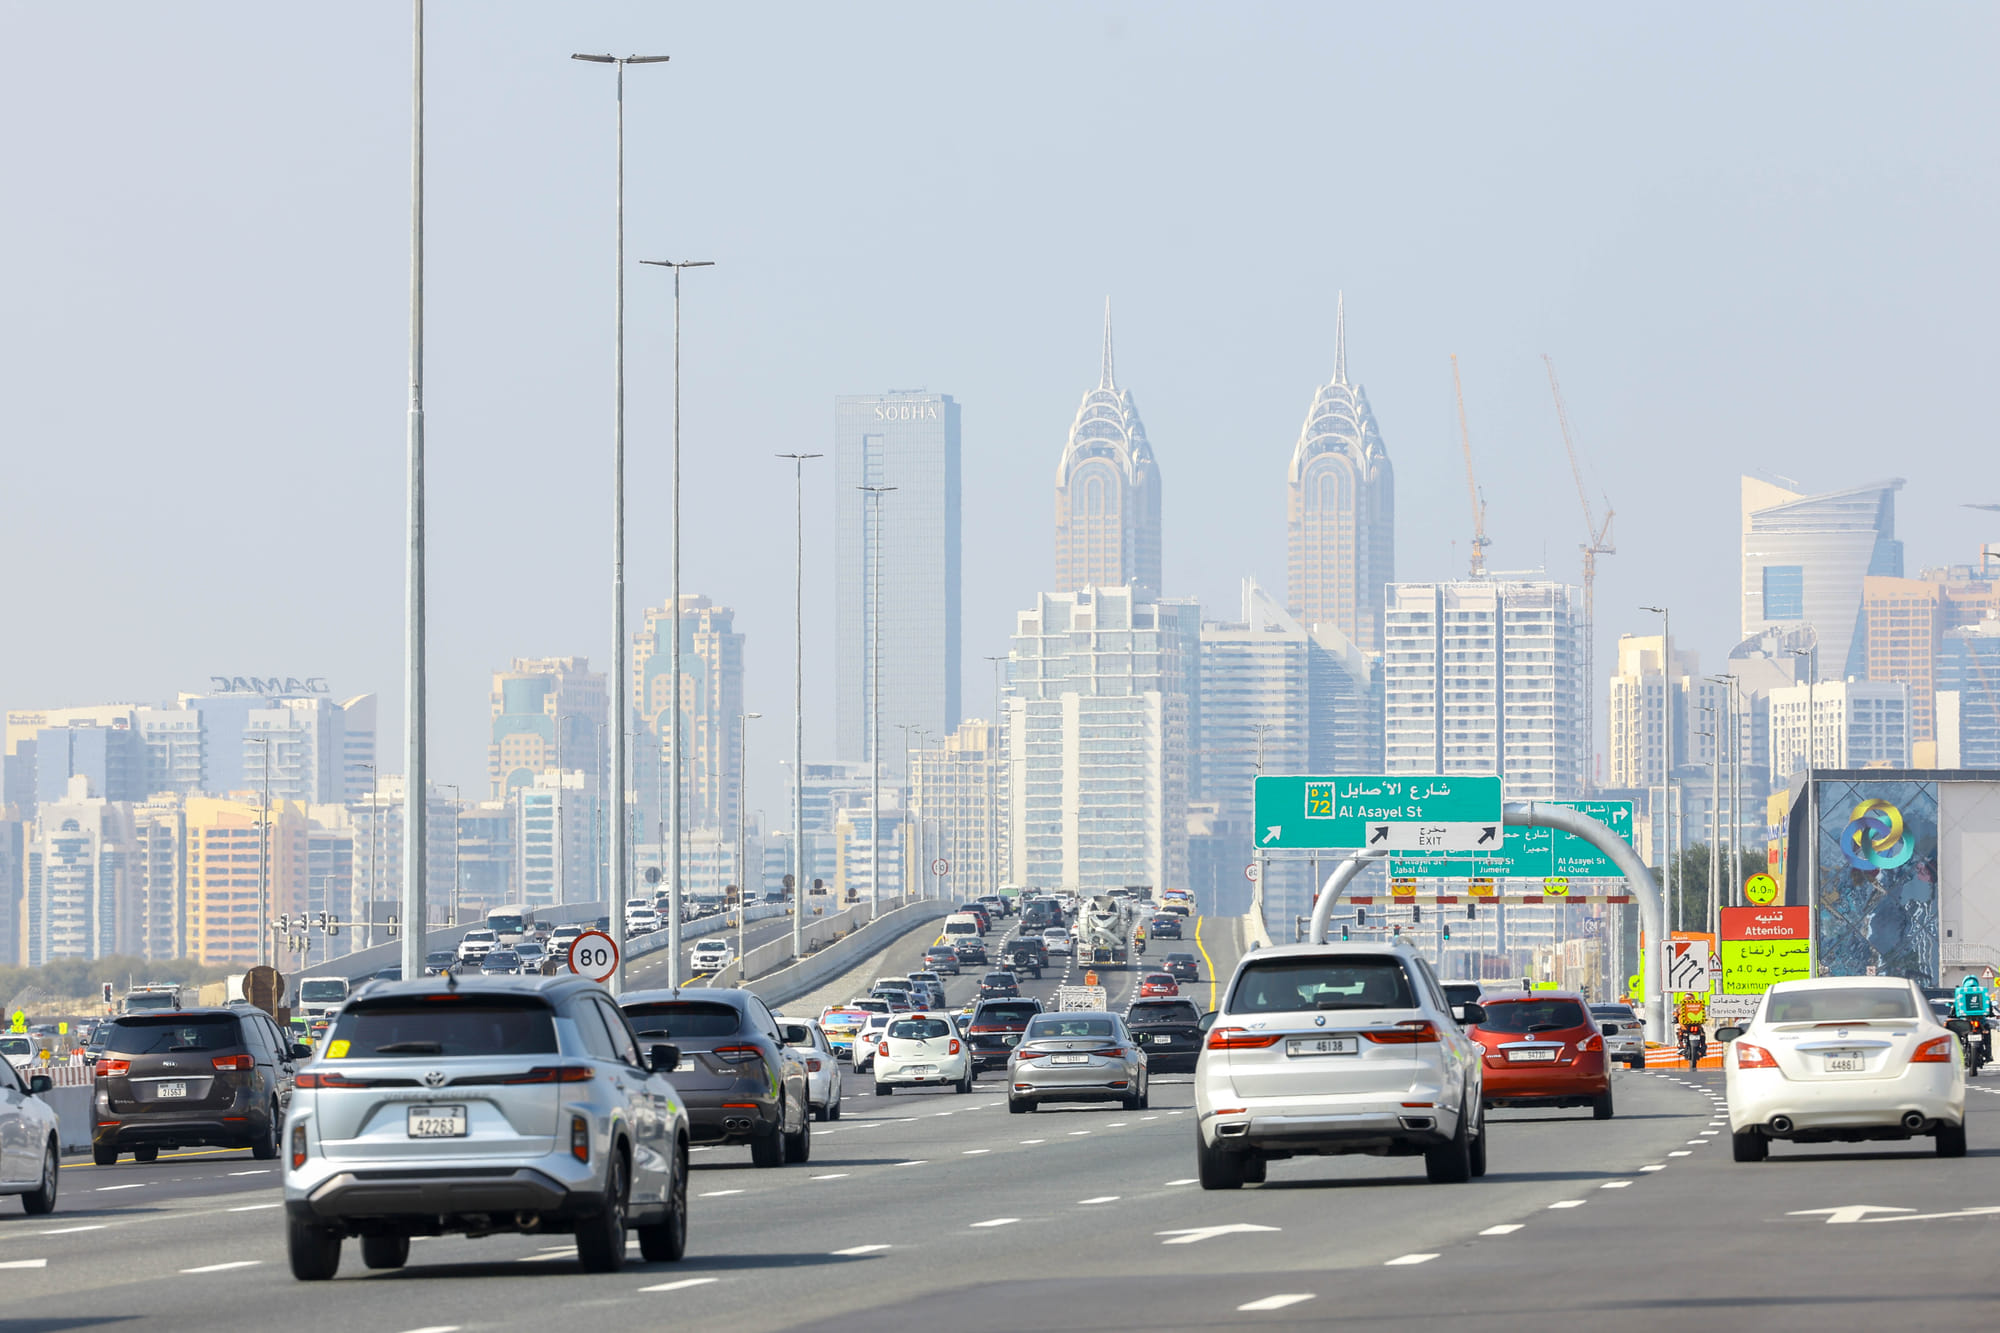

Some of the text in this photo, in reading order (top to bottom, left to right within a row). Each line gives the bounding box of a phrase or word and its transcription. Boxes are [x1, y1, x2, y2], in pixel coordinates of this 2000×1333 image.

[875, 405, 937, 421] SOBHA
[1311, 789, 1318, 797] D
[1410, 782, 1451, 800] شارع
[1310, 800, 1331, 814] 72
[1339, 806, 1423, 820] Al Asayel St
[1419, 826, 1447, 836] مخرج
[1418, 836, 1442, 846] EXIT
[1568, 857, 1595, 866] Asayel
[1596, 857, 1606, 865] St
[1394, 866, 1428, 874] Jabal Ali
[1480, 866, 1510, 874] Jumeira
[1568, 866, 1590, 874] Quoz
[1755, 911, 1784, 924] تنبيه
[1744, 926, 1794, 936] Attention
[1780, 944, 1809, 957] قصى
[580, 948, 608, 967] 80
[417, 1119, 455, 1134] 42263
